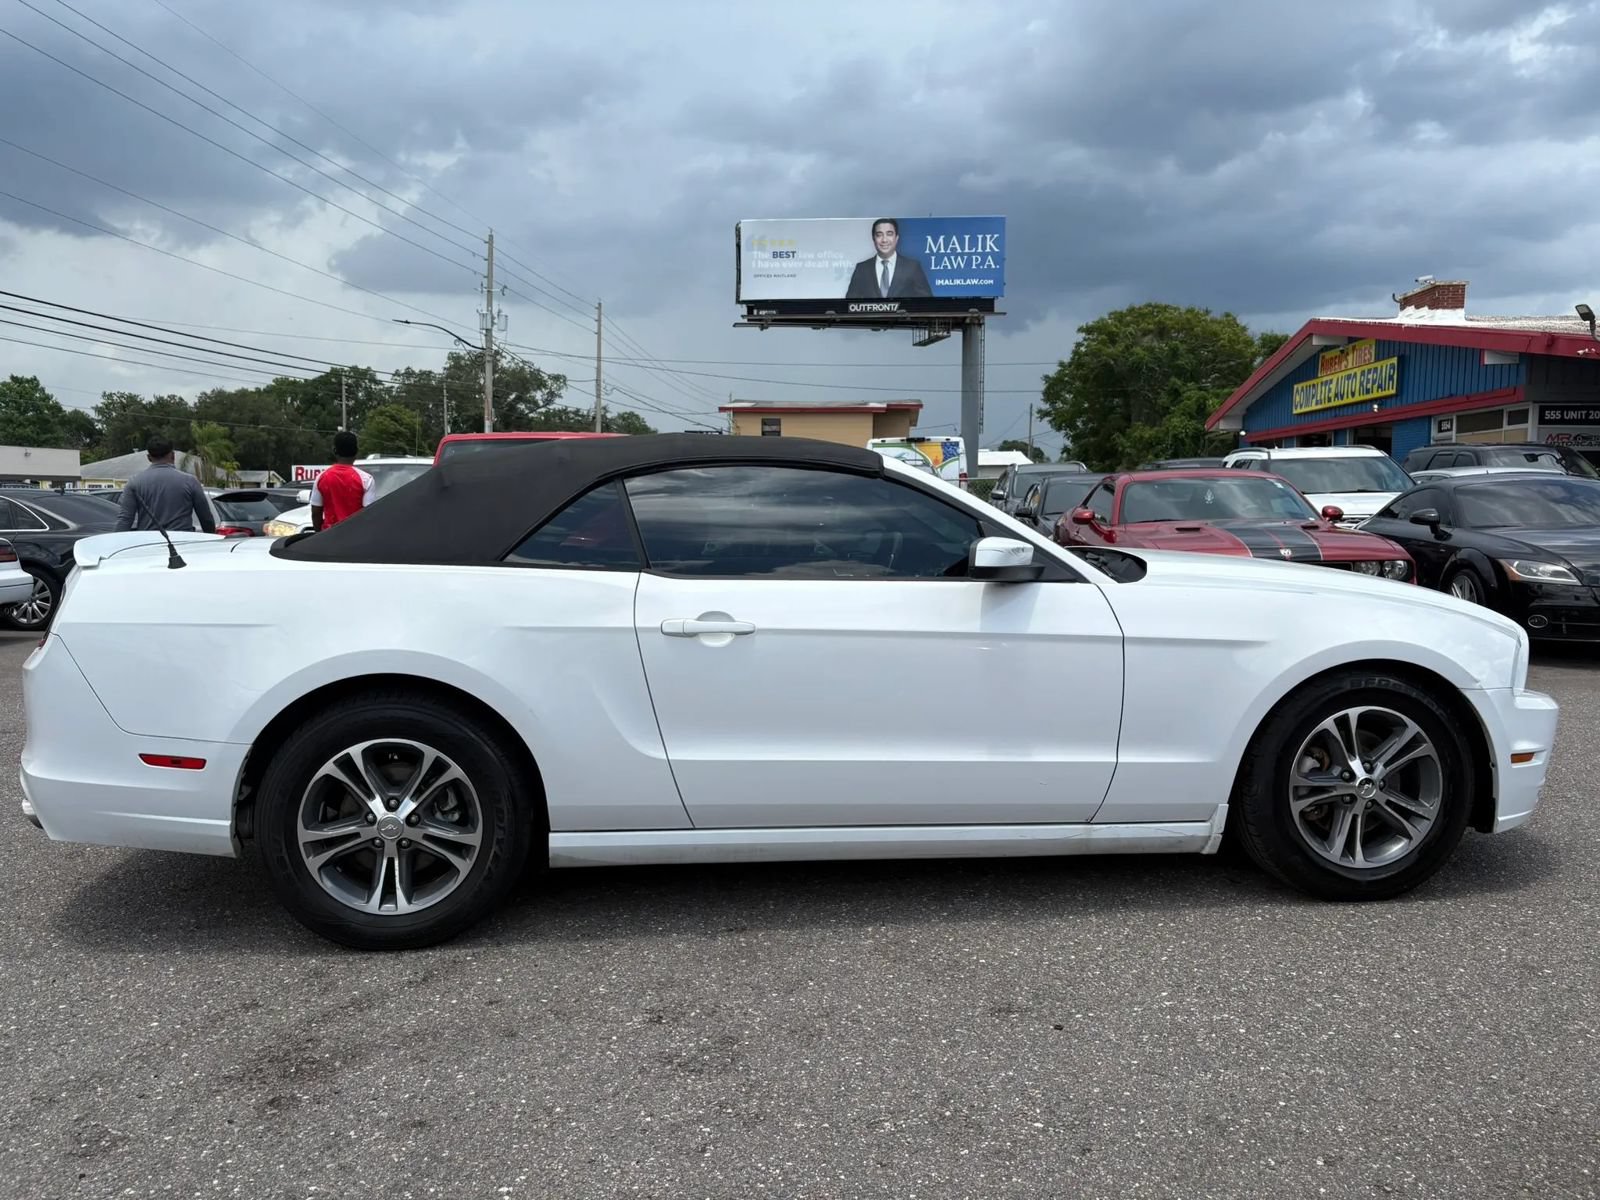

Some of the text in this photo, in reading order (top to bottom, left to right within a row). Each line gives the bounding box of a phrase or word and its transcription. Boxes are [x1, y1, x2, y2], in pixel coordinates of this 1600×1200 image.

[925, 234, 1000, 253] MALIK
[772, 250, 797, 259] BEST
[930, 255, 1000, 270] LAW P.A.
[1294, 362, 1396, 410] COMPLETE AUTO REPAIR
[1544, 410, 1562, 420] 555
[1563, 410, 1587, 420] UNIT
